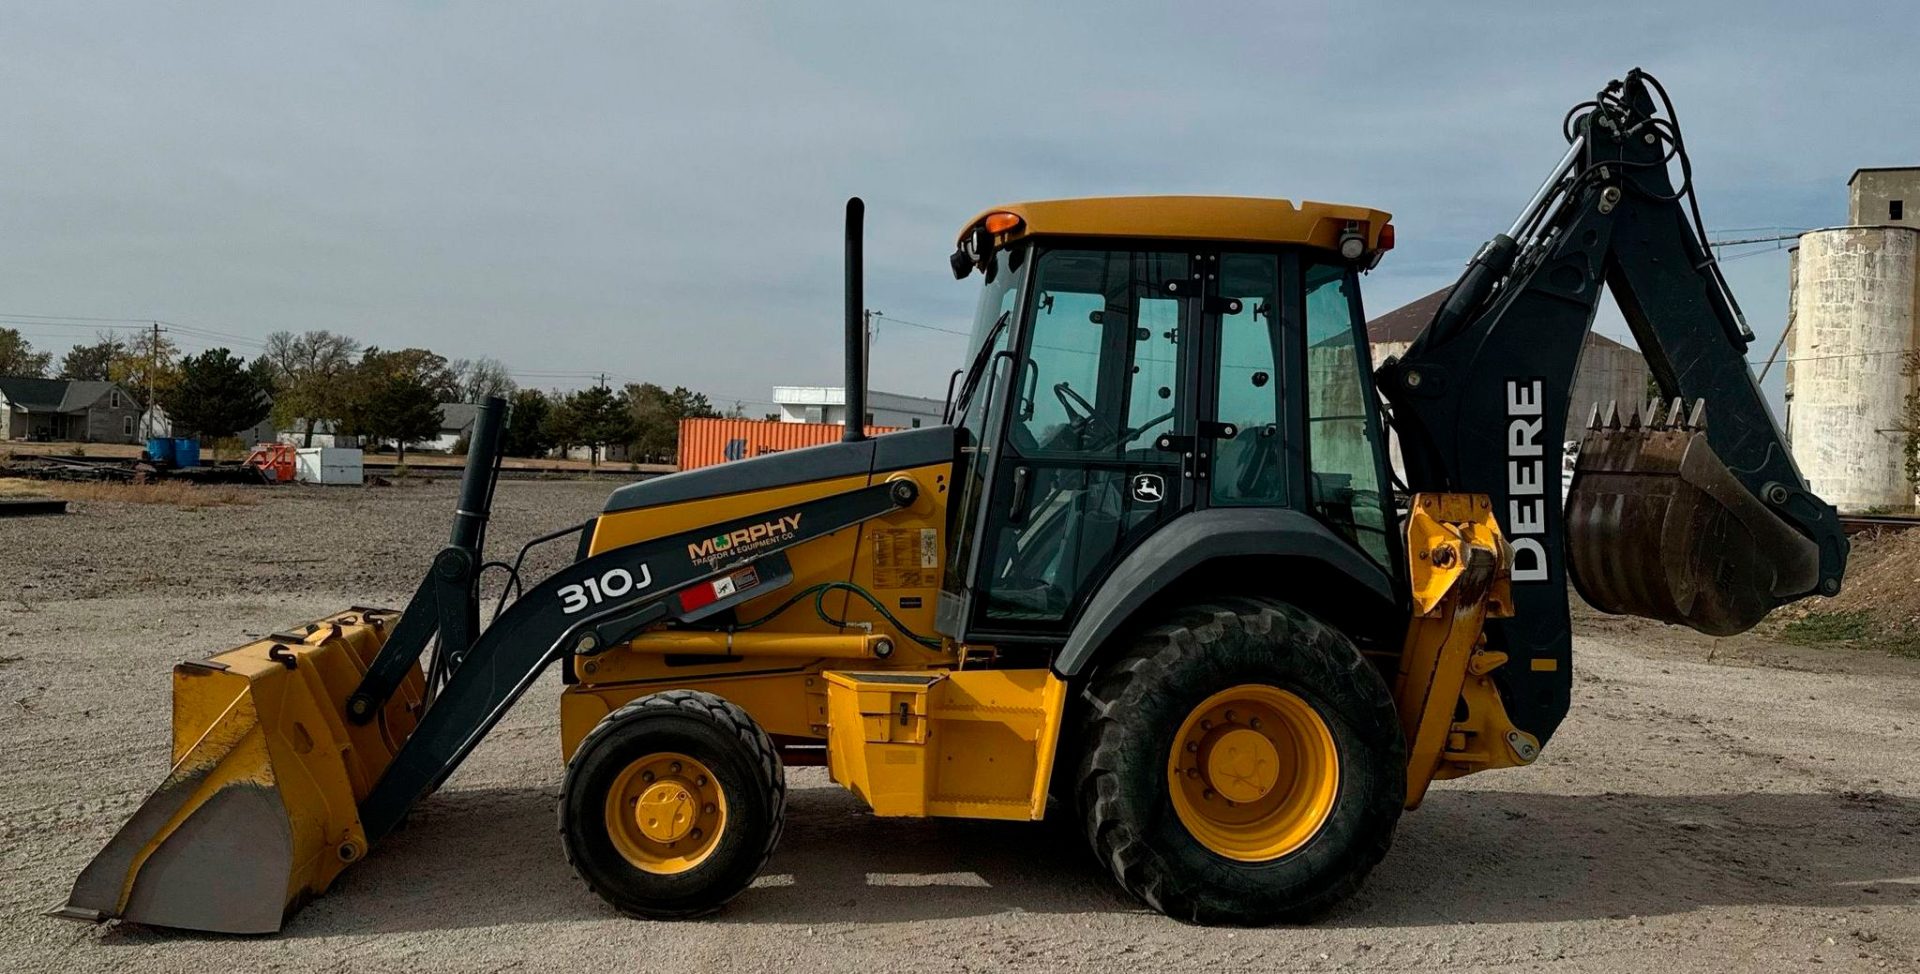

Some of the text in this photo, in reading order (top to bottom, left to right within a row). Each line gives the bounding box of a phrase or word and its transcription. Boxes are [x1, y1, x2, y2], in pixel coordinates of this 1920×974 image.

[1507, 380, 1548, 582] DEERE
[687, 512, 802, 559] MURPHY
[692, 532, 795, 566] TRACTOR & EQUIPMENT CO.
[557, 563, 652, 614] 310J
